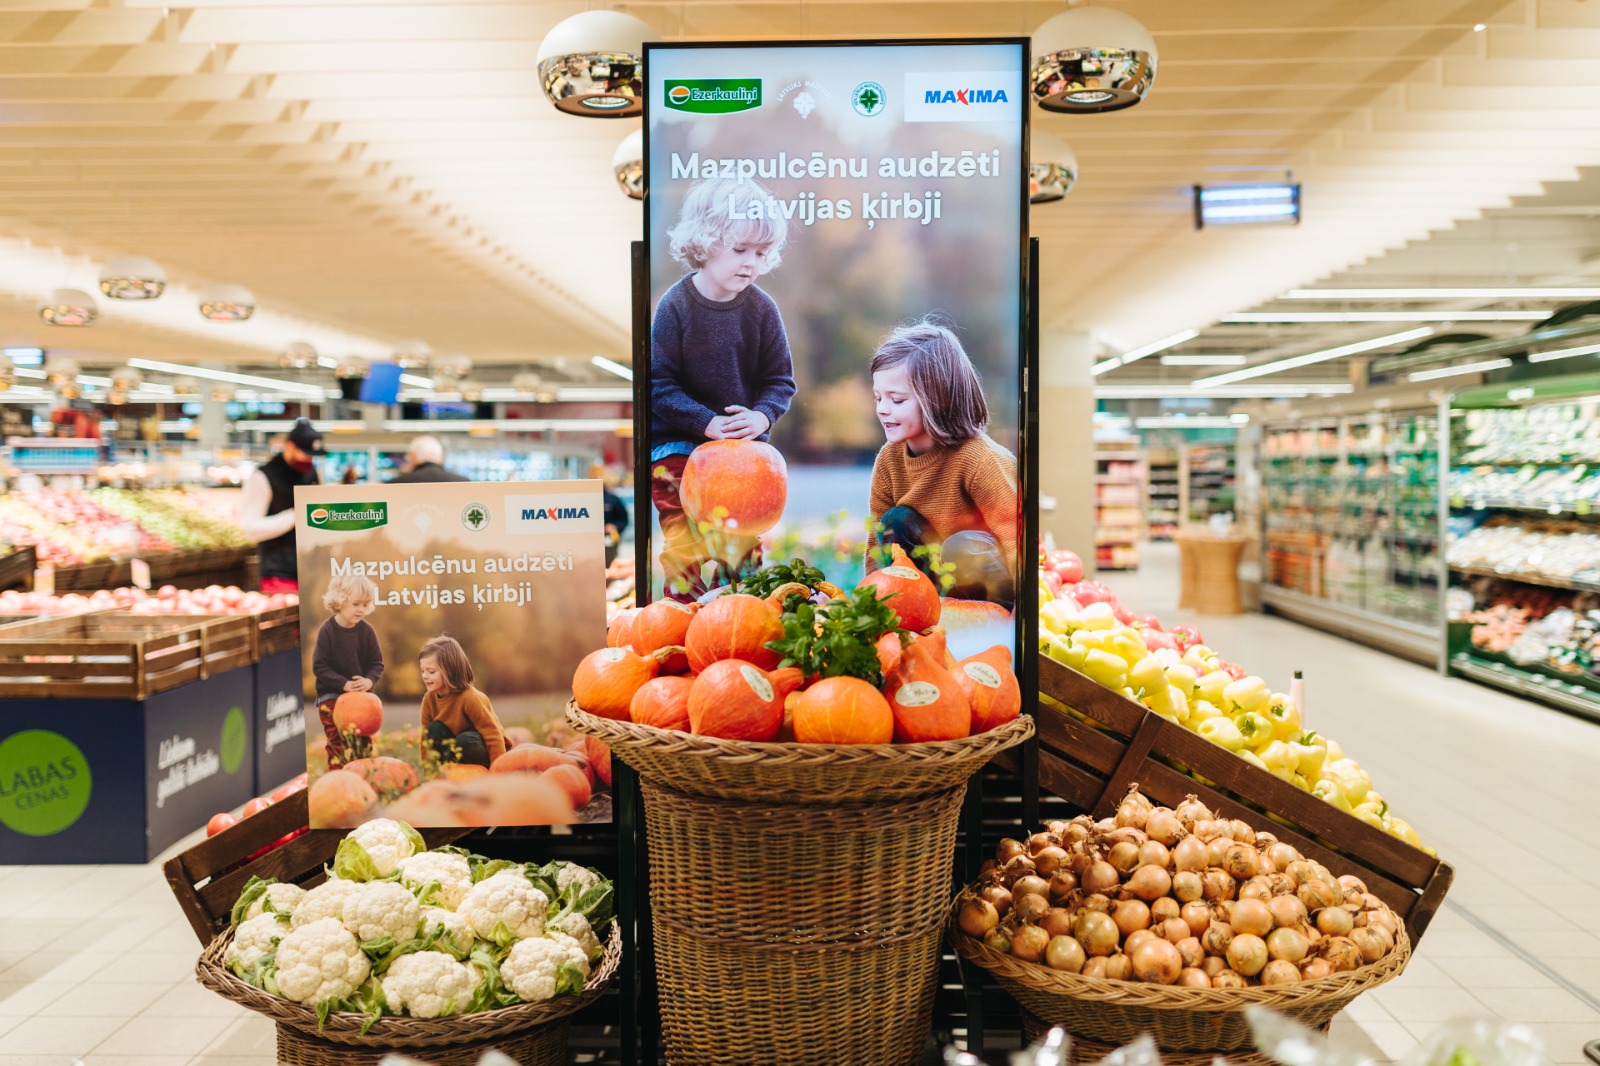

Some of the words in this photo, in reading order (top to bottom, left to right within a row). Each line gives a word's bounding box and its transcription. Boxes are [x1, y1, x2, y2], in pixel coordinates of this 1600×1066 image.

[692, 87, 758, 104] Ezerkauliņi
[776, 80, 802, 103] LATVIJAS
[924, 88, 1008, 105] MAXIMA
[670, 152, 868, 184] Mazpulcēnu
[878, 149, 1000, 178] audzēti
[728, 192, 852, 226] Latvijas
[862, 191, 942, 230] ķirbji
[328, 508, 385, 523] Ezerkauliņi
[521, 506, 590, 521] MAXIMA
[330, 555, 476, 580] Mazpulcēnu
[484, 550, 574, 574] audzēti
[373, 584, 466, 609] Latvijas
[473, 582, 532, 611] ķirbji
[0, 756, 77, 797] LABAS
[16, 782, 69, 811] CENAS
